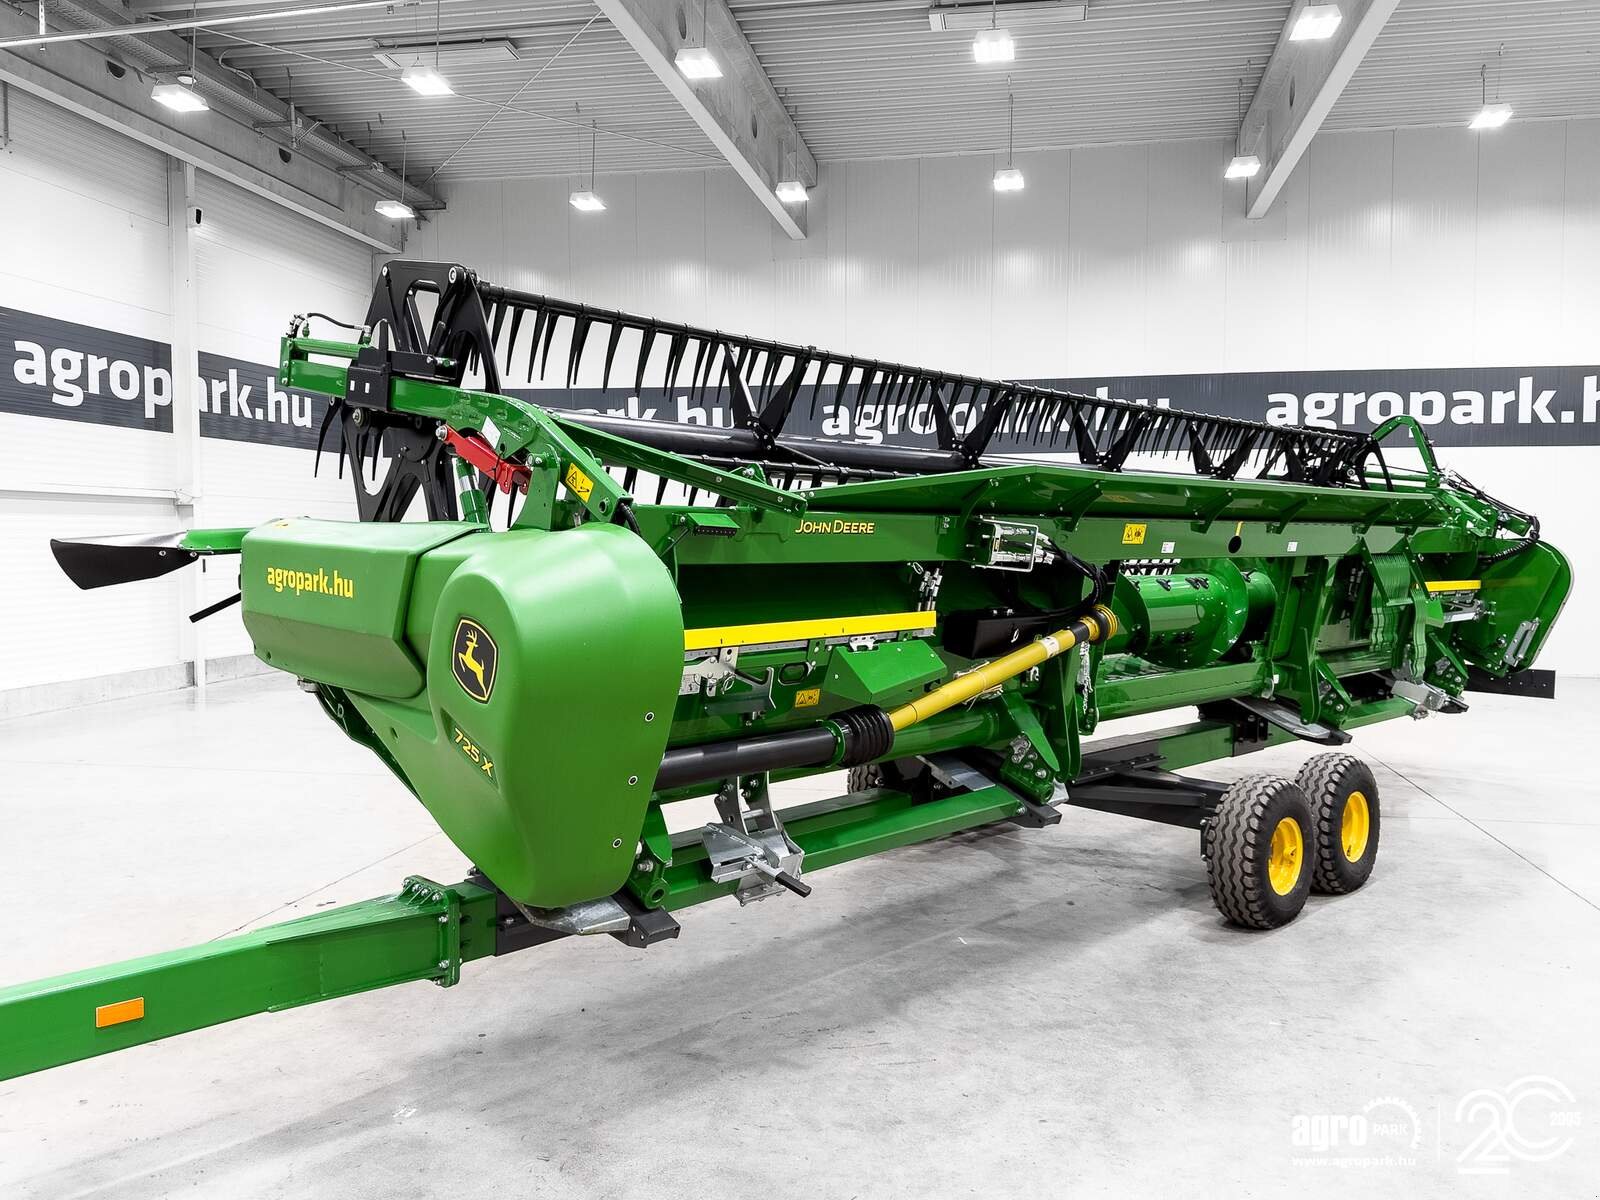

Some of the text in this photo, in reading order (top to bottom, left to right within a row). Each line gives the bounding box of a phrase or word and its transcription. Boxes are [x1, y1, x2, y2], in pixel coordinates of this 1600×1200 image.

[13, 340, 313, 429] agroprk.hu
[795, 519, 876, 535] JOHN DEERE
[267, 567, 354, 599] agropark.hu
[454, 727, 494, 778] 725 X
